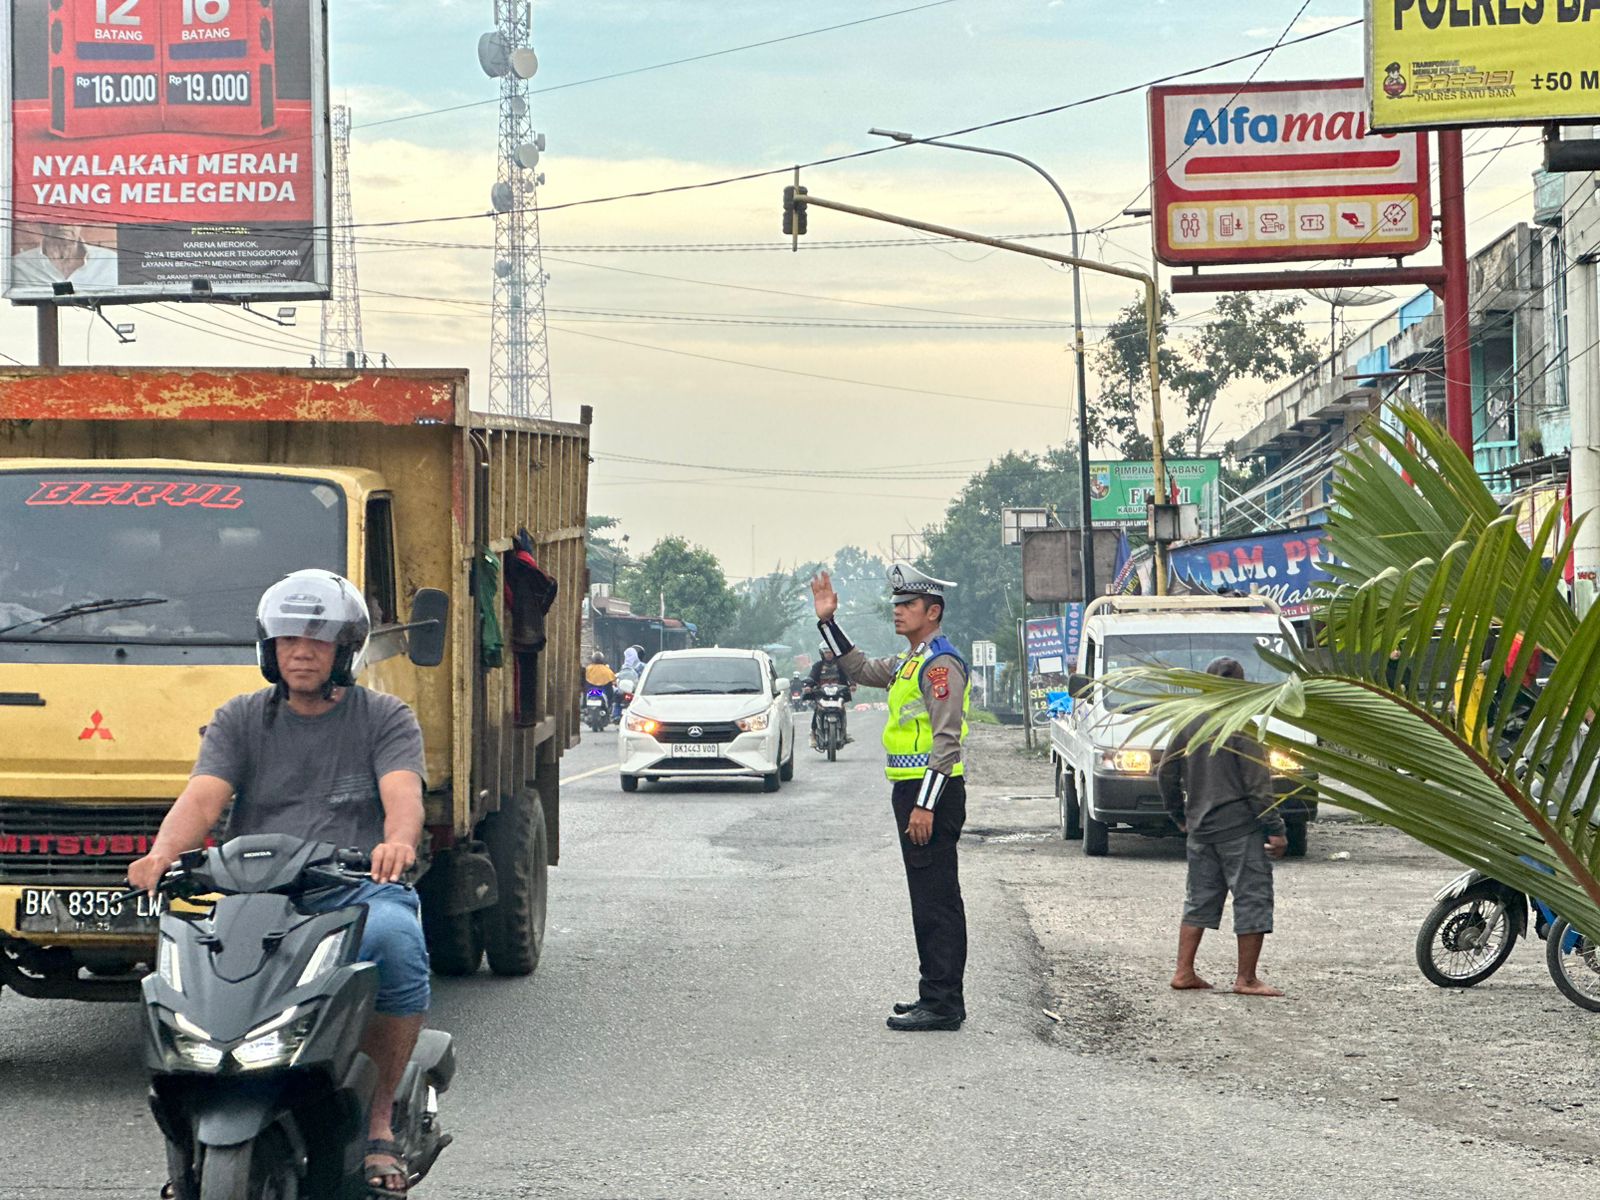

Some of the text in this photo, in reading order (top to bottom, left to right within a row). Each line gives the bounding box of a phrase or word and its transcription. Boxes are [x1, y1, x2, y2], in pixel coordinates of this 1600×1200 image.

[1394, 0, 1545, 30] POLRES
[95, 29, 143, 41] BATANG
[181, 27, 231, 41] BATANG
[76, 75, 156, 104] Rp 16.000
[168, 73, 248, 102] Rp 19.000
[1417, 91, 1457, 102] POLRES
[1460, 90, 1486, 100] BATU
[1184, 106, 1397, 146] Alfamar
[32, 152, 298, 177] NYALAKAN MERAH
[32, 181, 296, 205] YANG MELEGENDA
[203, 250, 235, 258] KANKER
[1208, 544, 1277, 586] RM.
[26, 891, 51, 915] BK
[136, 892, 163, 917] LW
